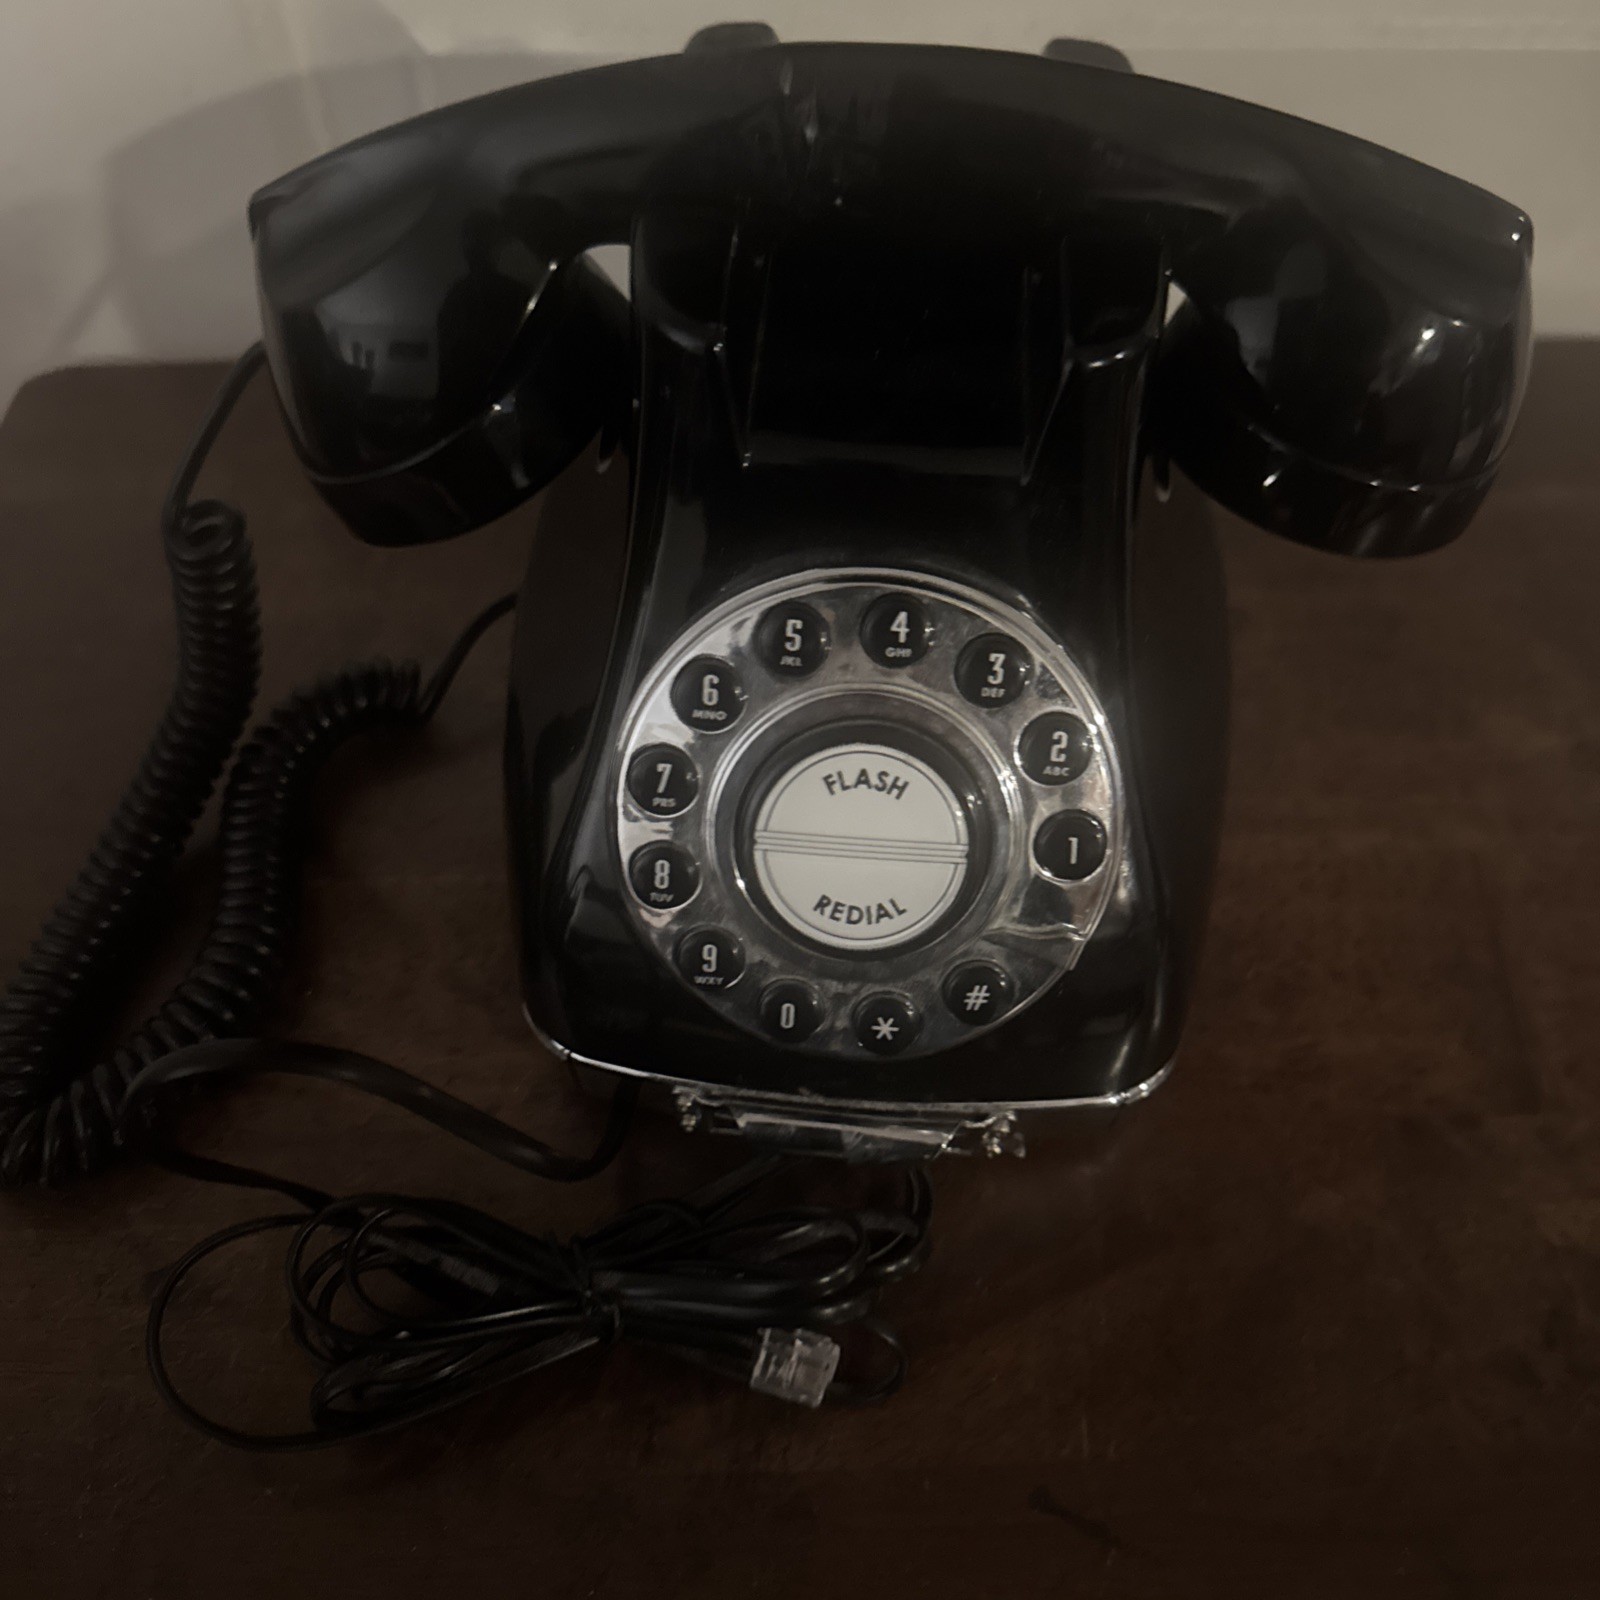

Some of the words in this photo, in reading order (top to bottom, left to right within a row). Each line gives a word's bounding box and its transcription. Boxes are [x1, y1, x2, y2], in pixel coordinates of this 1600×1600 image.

[784, 619, 803, 651] 5
[890, 611, 910, 643] 4
[987, 653, 1006, 684] 3
[702, 675, 720, 706] 6
[980, 687, 1006, 699] DEF
[692, 710, 728, 721] MNO
[1050, 731, 1069, 763] 2
[656, 763, 673, 793] 7
[822, 768, 909, 800] FLASH
[1042, 766, 1070, 777] ABC
[1068, 837, 1079, 864] 1
[654, 859, 671, 890] 8
[812, 894, 908, 925] REDIAL
[701, 944, 718, 973] 9
[693, 975, 724, 986] WXY
[963, 985, 991, 1011] #
[779, 1003, 796, 1029] 0
